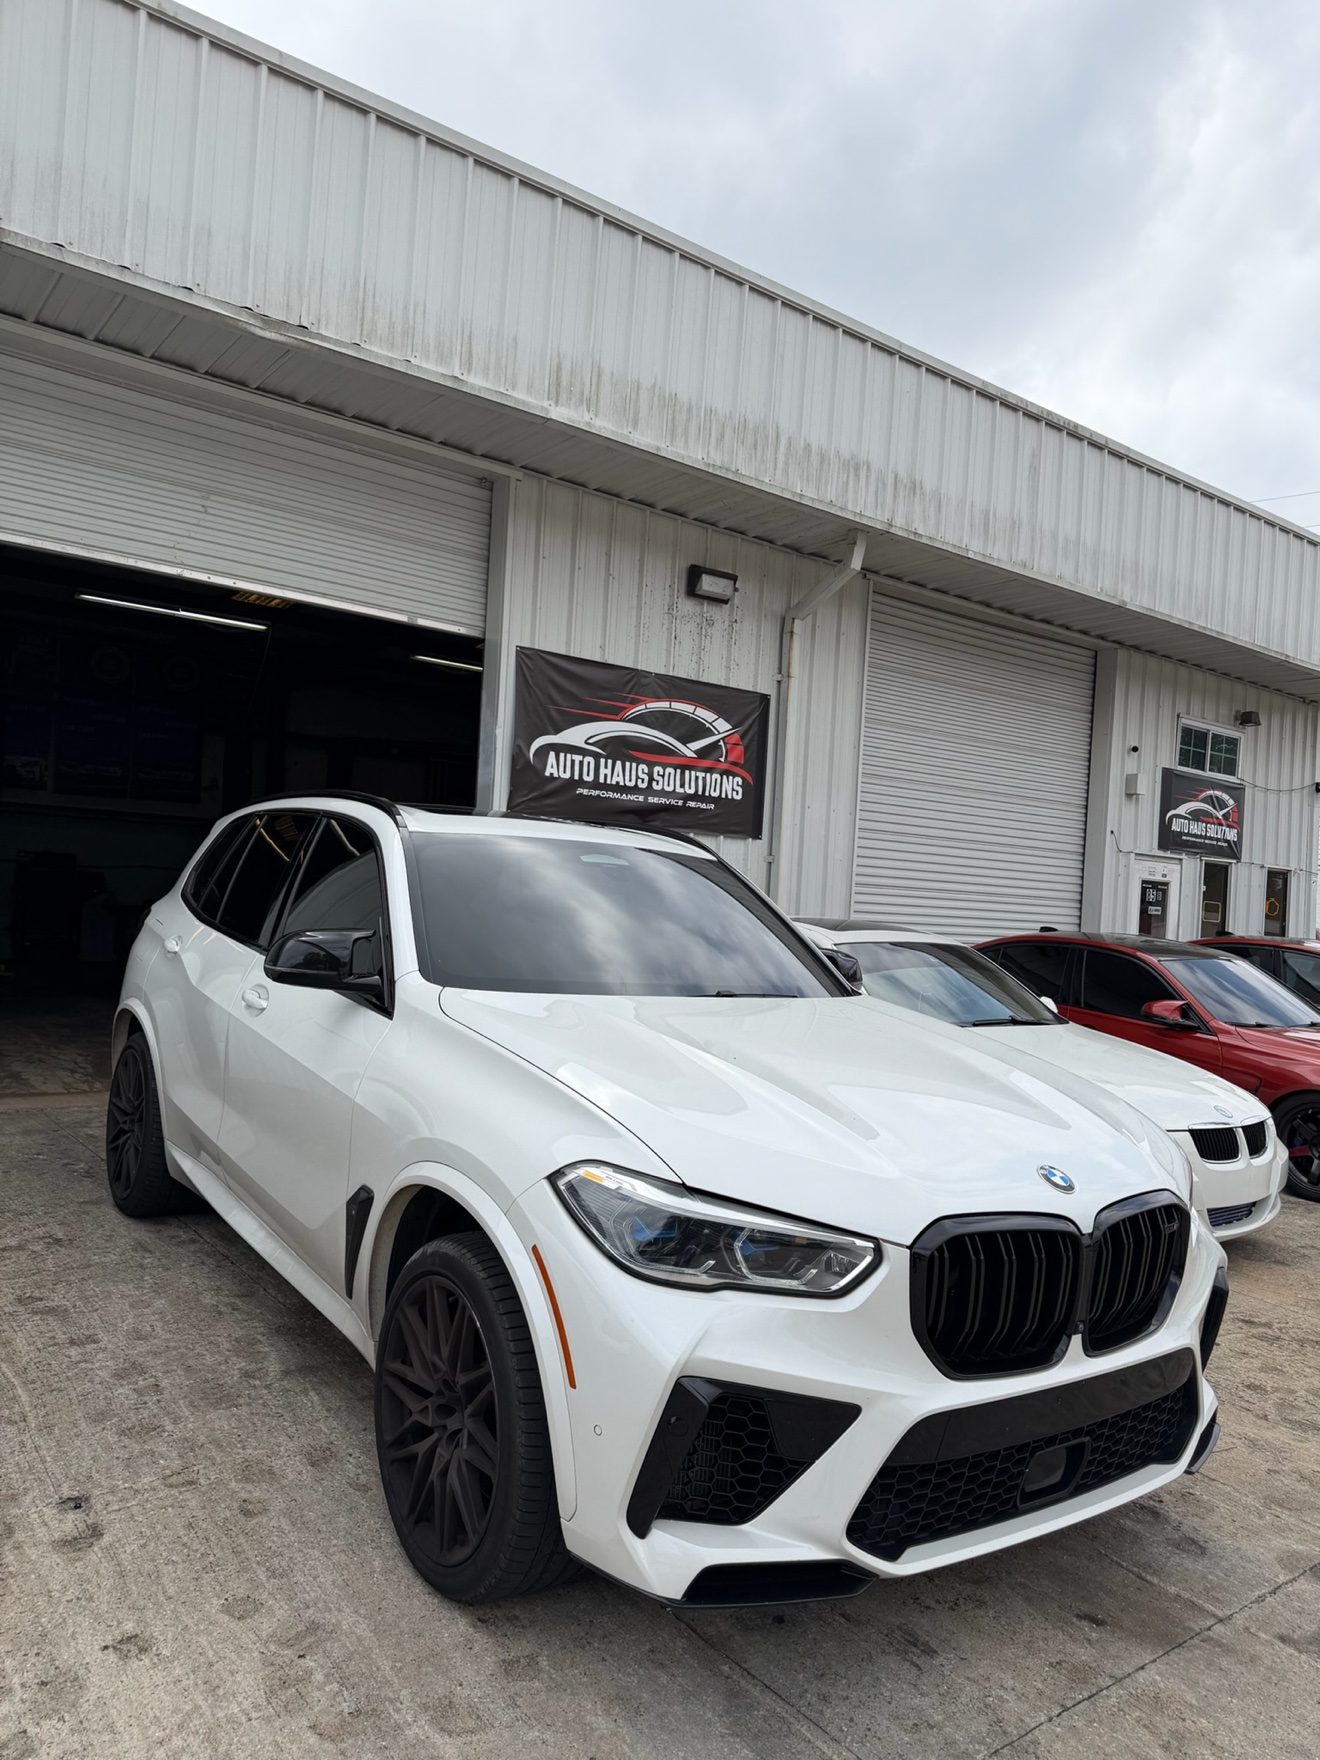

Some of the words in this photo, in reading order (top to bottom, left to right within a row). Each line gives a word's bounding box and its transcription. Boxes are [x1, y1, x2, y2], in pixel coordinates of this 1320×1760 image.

[544, 751, 595, 782] AUTO
[599, 758, 649, 789] HAUS
[652, 766, 743, 800] SOLUTIONS
[576, 788, 644, 802] PERFORMANCE
[647, 796, 683, 807] SERVICE
[686, 800, 715, 810] REPAIR
[1171, 818, 1189, 833] AUTO
[1189, 821, 1206, 836] HAUS
[1206, 824, 1238, 841] SOLUTIONS
